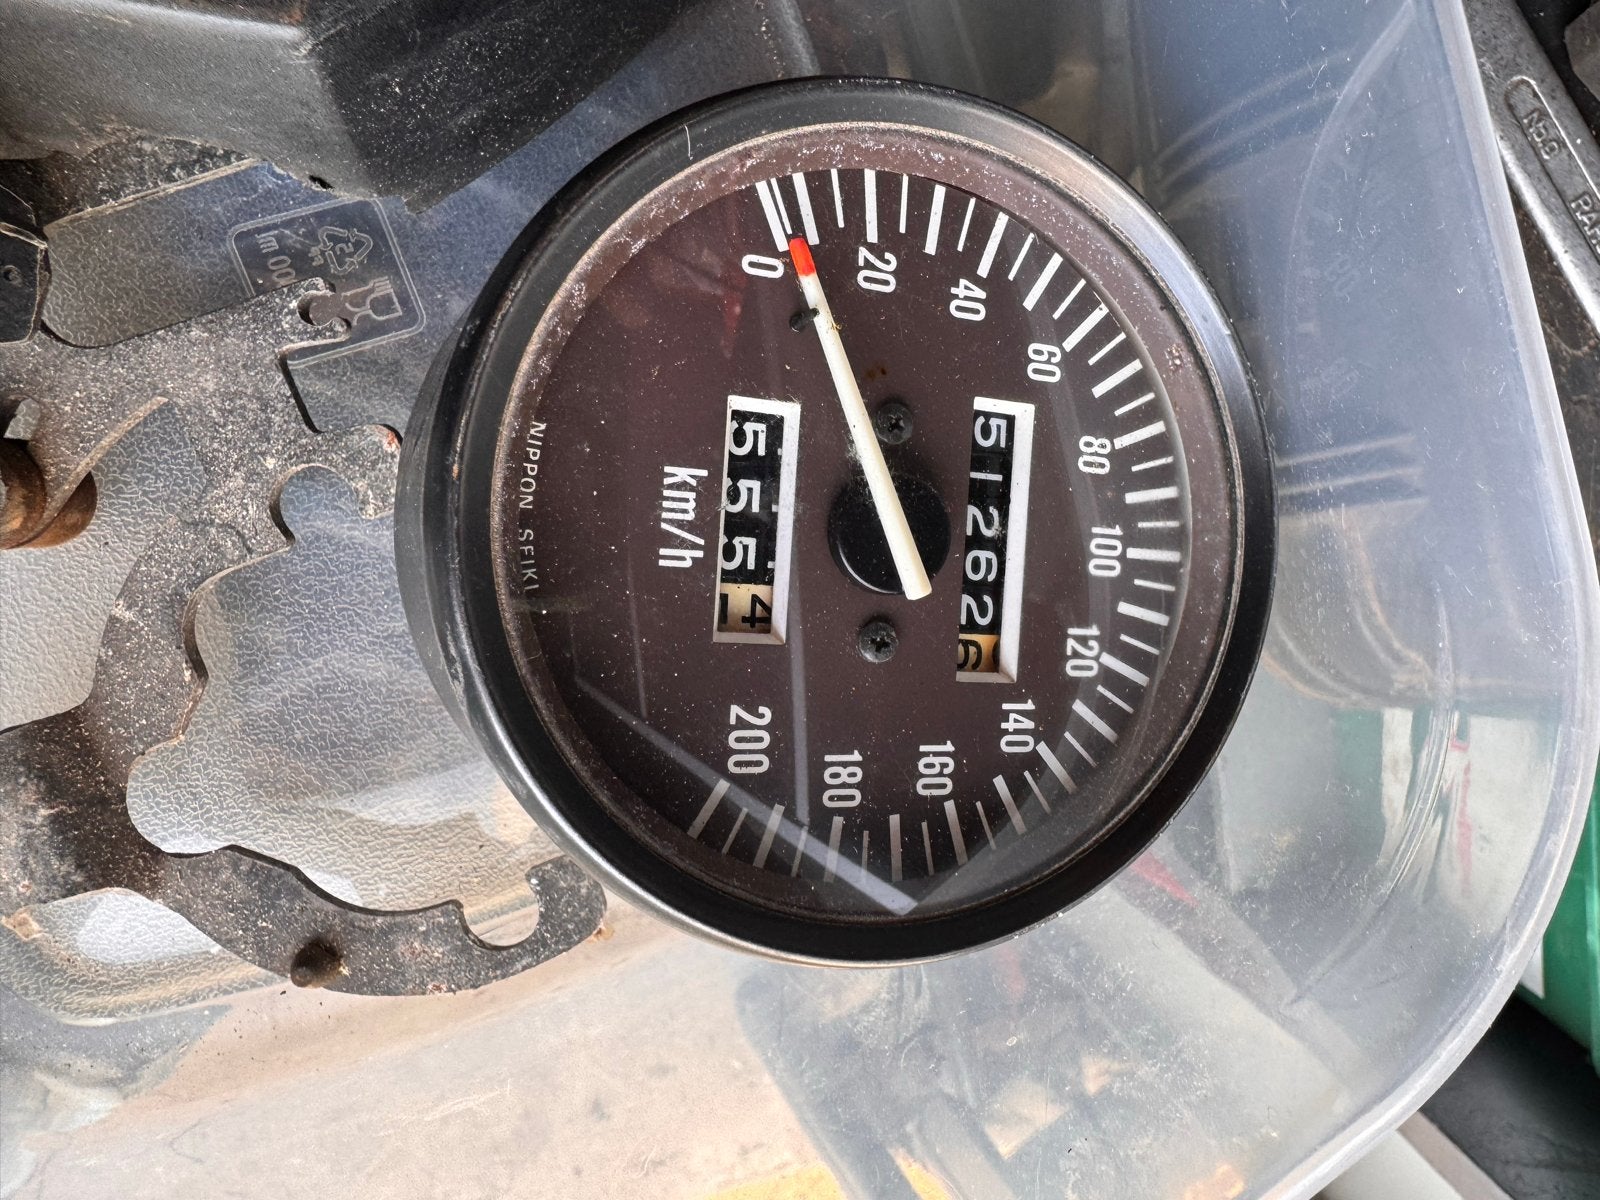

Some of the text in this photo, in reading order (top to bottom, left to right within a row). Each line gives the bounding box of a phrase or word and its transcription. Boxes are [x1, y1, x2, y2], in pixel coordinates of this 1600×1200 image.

[741, 253, 785, 279] 0
[857, 246, 898, 293] 20
[949, 279, 987, 322] 40
[1026, 342, 1062, 384] 60
[519, 421, 547, 509] NIPPON
[1078, 435, 1112, 476] 80
[657, 465, 708, 568] km/h
[1089, 523, 1124, 577] 100
[1065, 624, 1100, 678] 120
[727, 704, 772, 774] 200
[1000, 698, 1036, 754] 140
[822, 748, 863, 808] 180
[915, 739, 955, 797] 160
